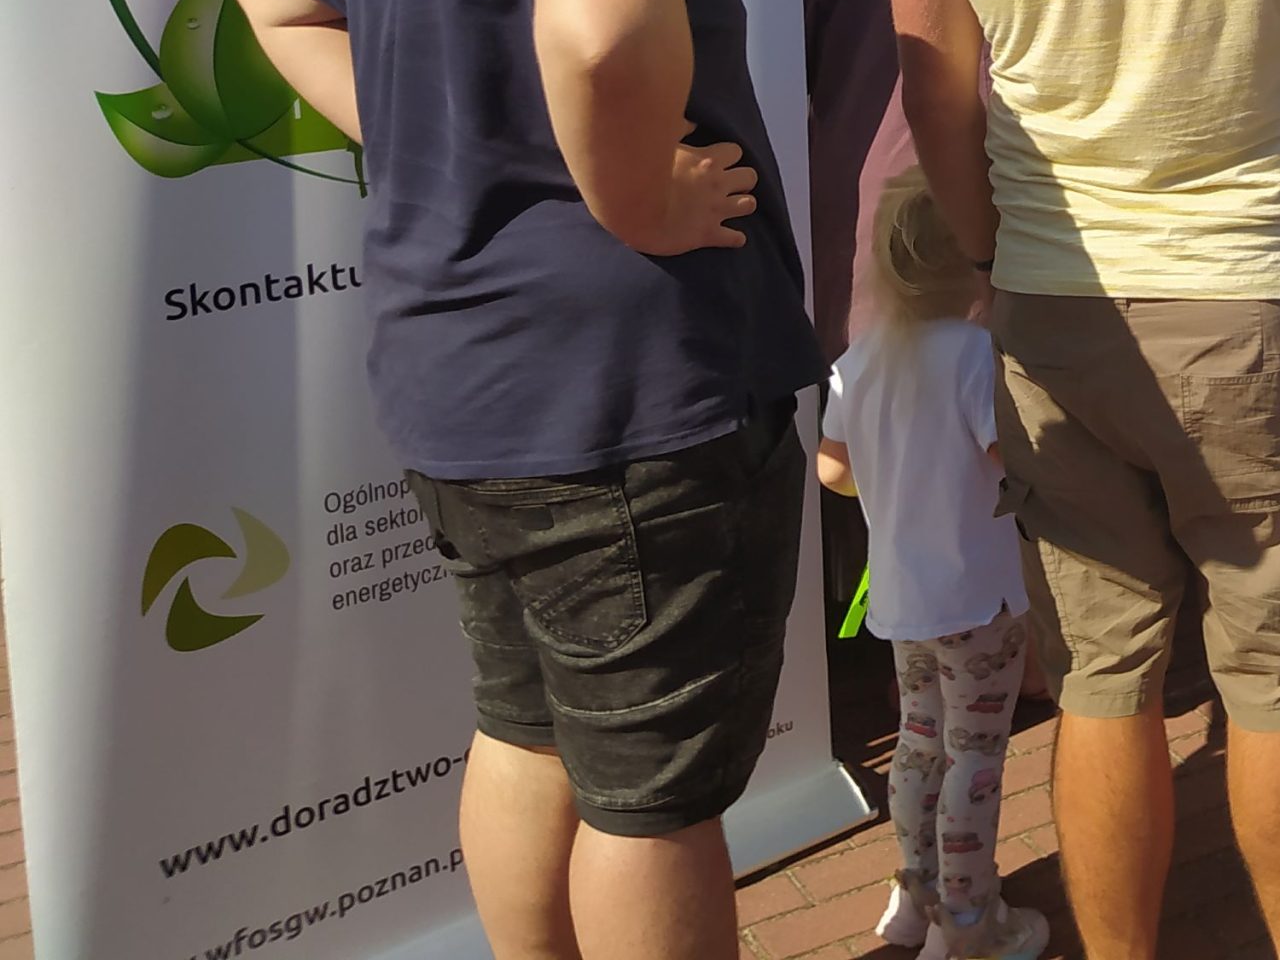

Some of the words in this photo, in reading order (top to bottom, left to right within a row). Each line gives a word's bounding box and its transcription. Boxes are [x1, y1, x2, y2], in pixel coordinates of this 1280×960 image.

[164, 263, 363, 321] Skontaktu
[324, 478, 411, 514] Ogólnop
[326, 522, 358, 546] dla
[329, 552, 375, 578] oraz
[332, 564, 454, 610] energetycz
[767, 721, 793, 739] oku
[159, 746, 470, 878] www.doradztwo-
